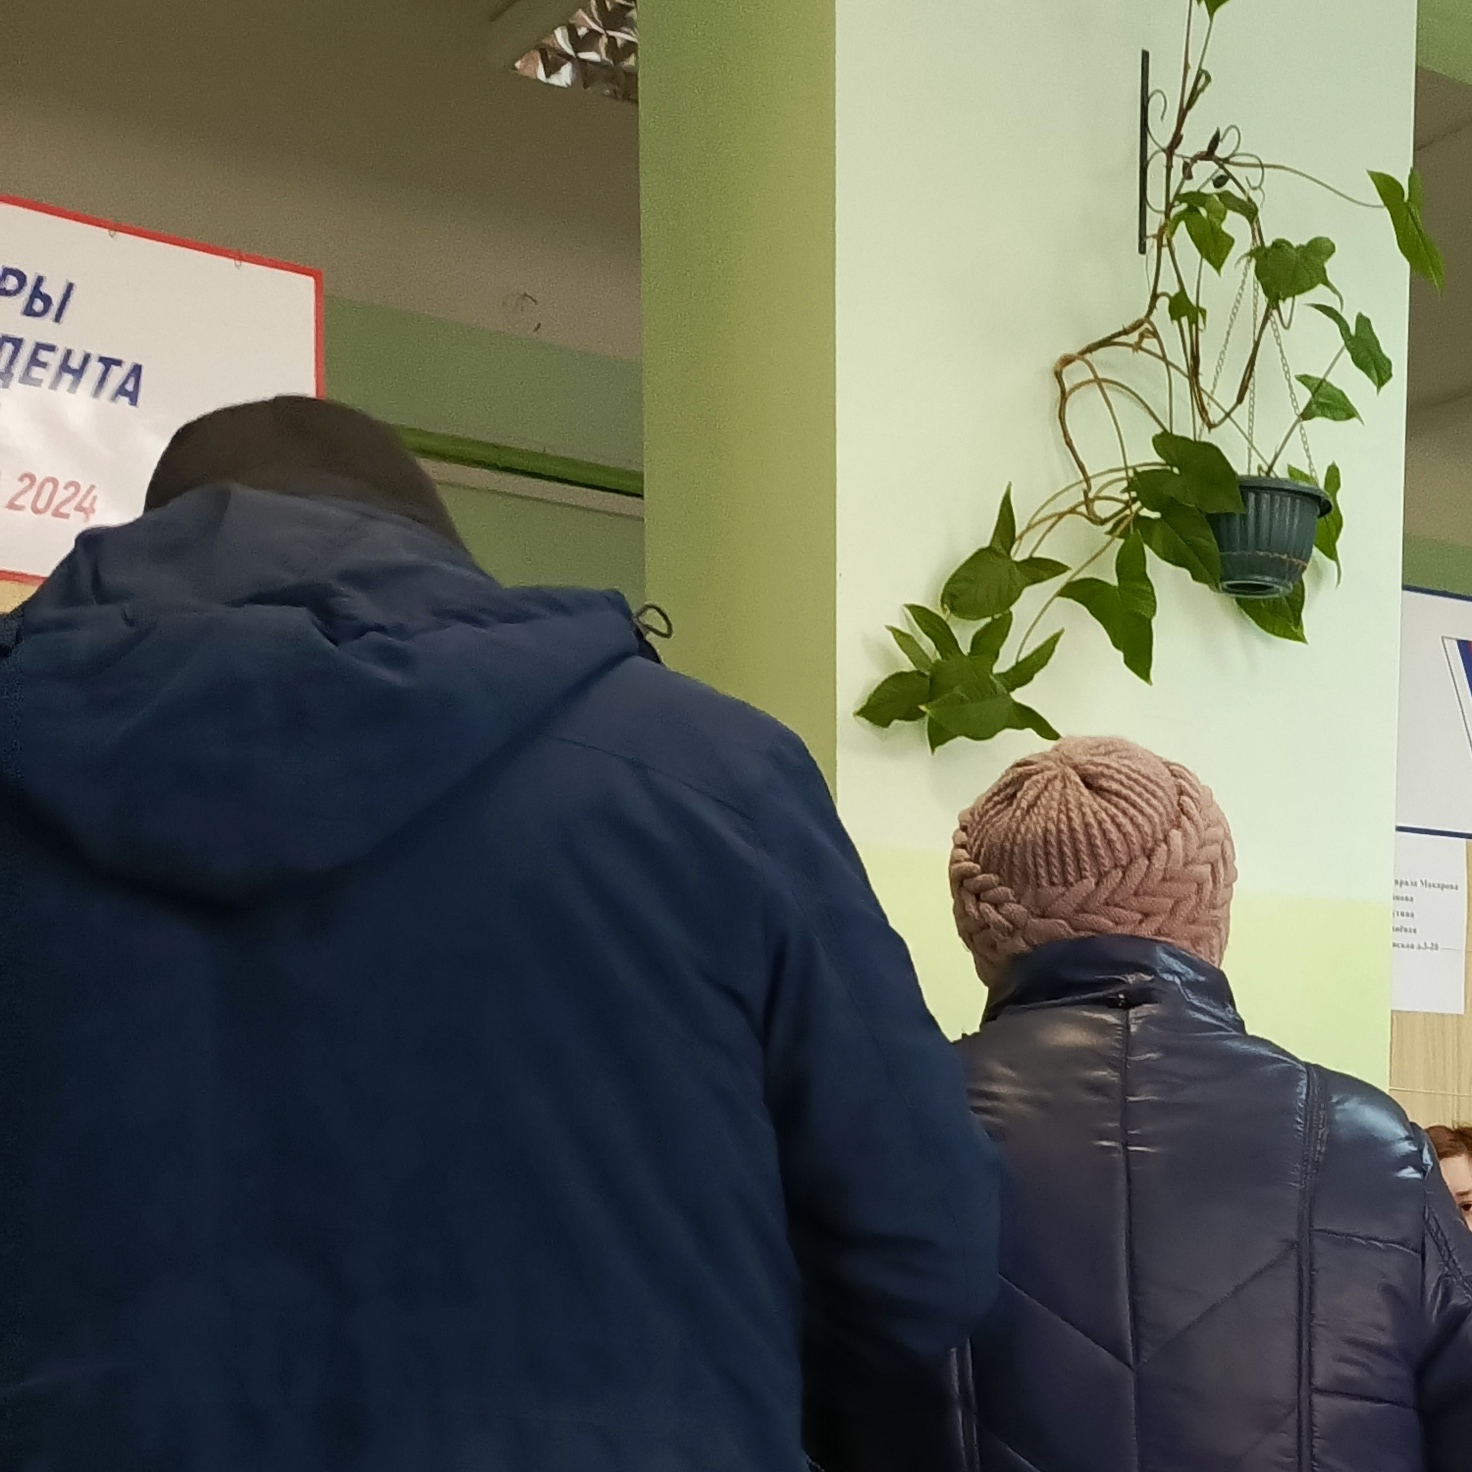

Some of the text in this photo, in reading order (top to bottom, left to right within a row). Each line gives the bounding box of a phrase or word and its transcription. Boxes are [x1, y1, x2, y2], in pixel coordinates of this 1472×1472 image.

[0, 267, 74, 323] РЫ
[0, 335, 142, 406] ДЕНТА
[5, 472, 97, 522] 2024
